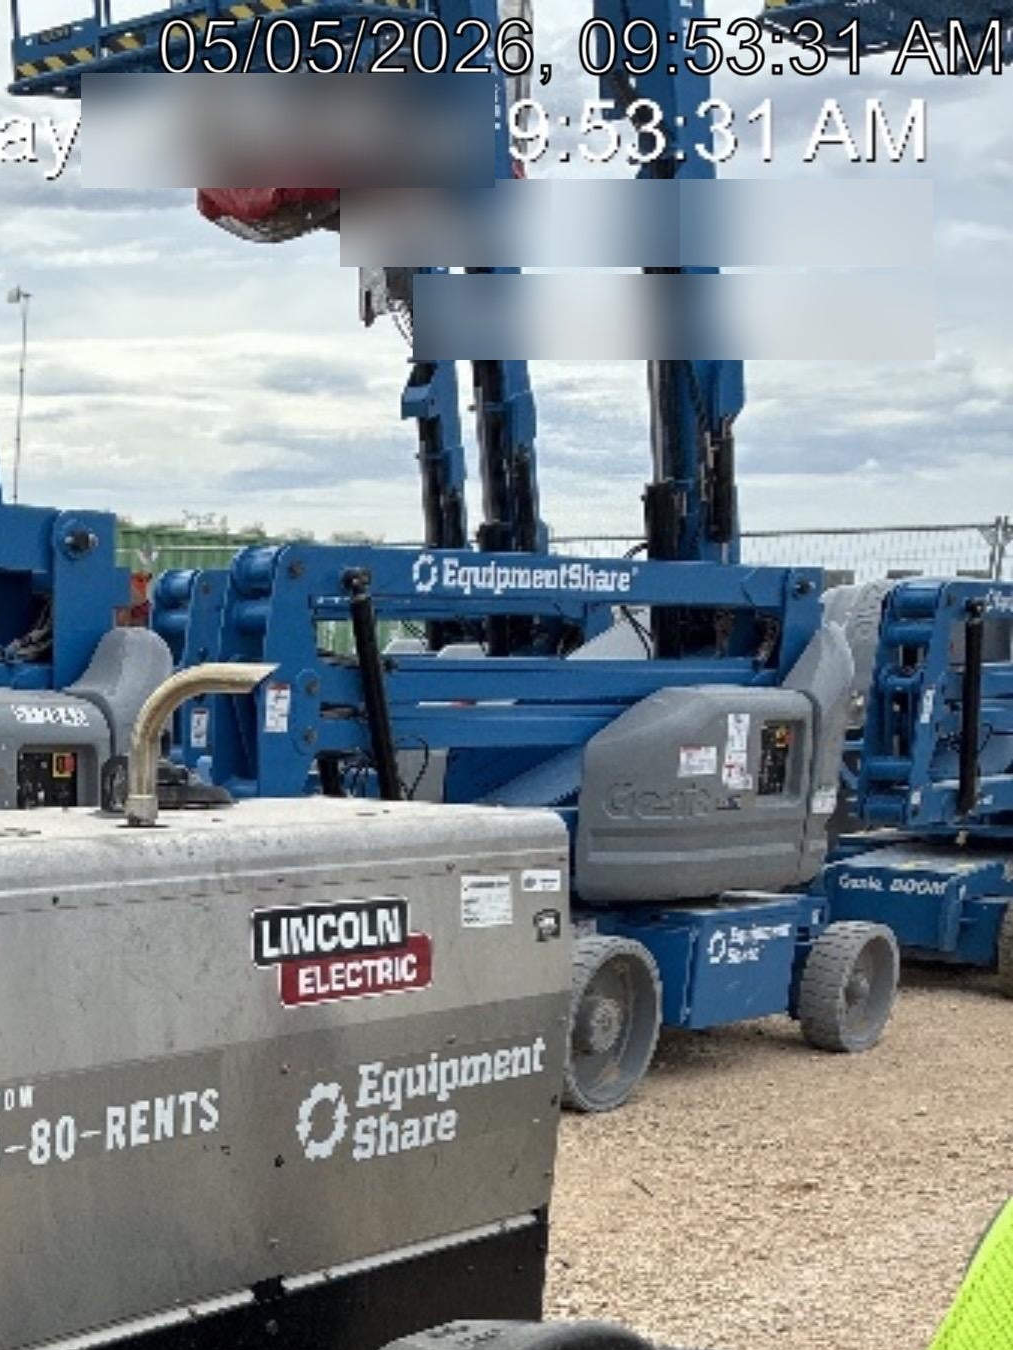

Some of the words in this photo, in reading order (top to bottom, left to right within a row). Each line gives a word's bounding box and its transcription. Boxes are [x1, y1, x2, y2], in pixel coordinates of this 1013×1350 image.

[443, 557, 631, 595] EquipmentShare
[261, 905, 402, 959] LINCOLN
[298, 953, 418, 997] ELECTRIC
[355, 1037, 547, 1111] Equipment
[351, 1109, 459, 1162] Share
